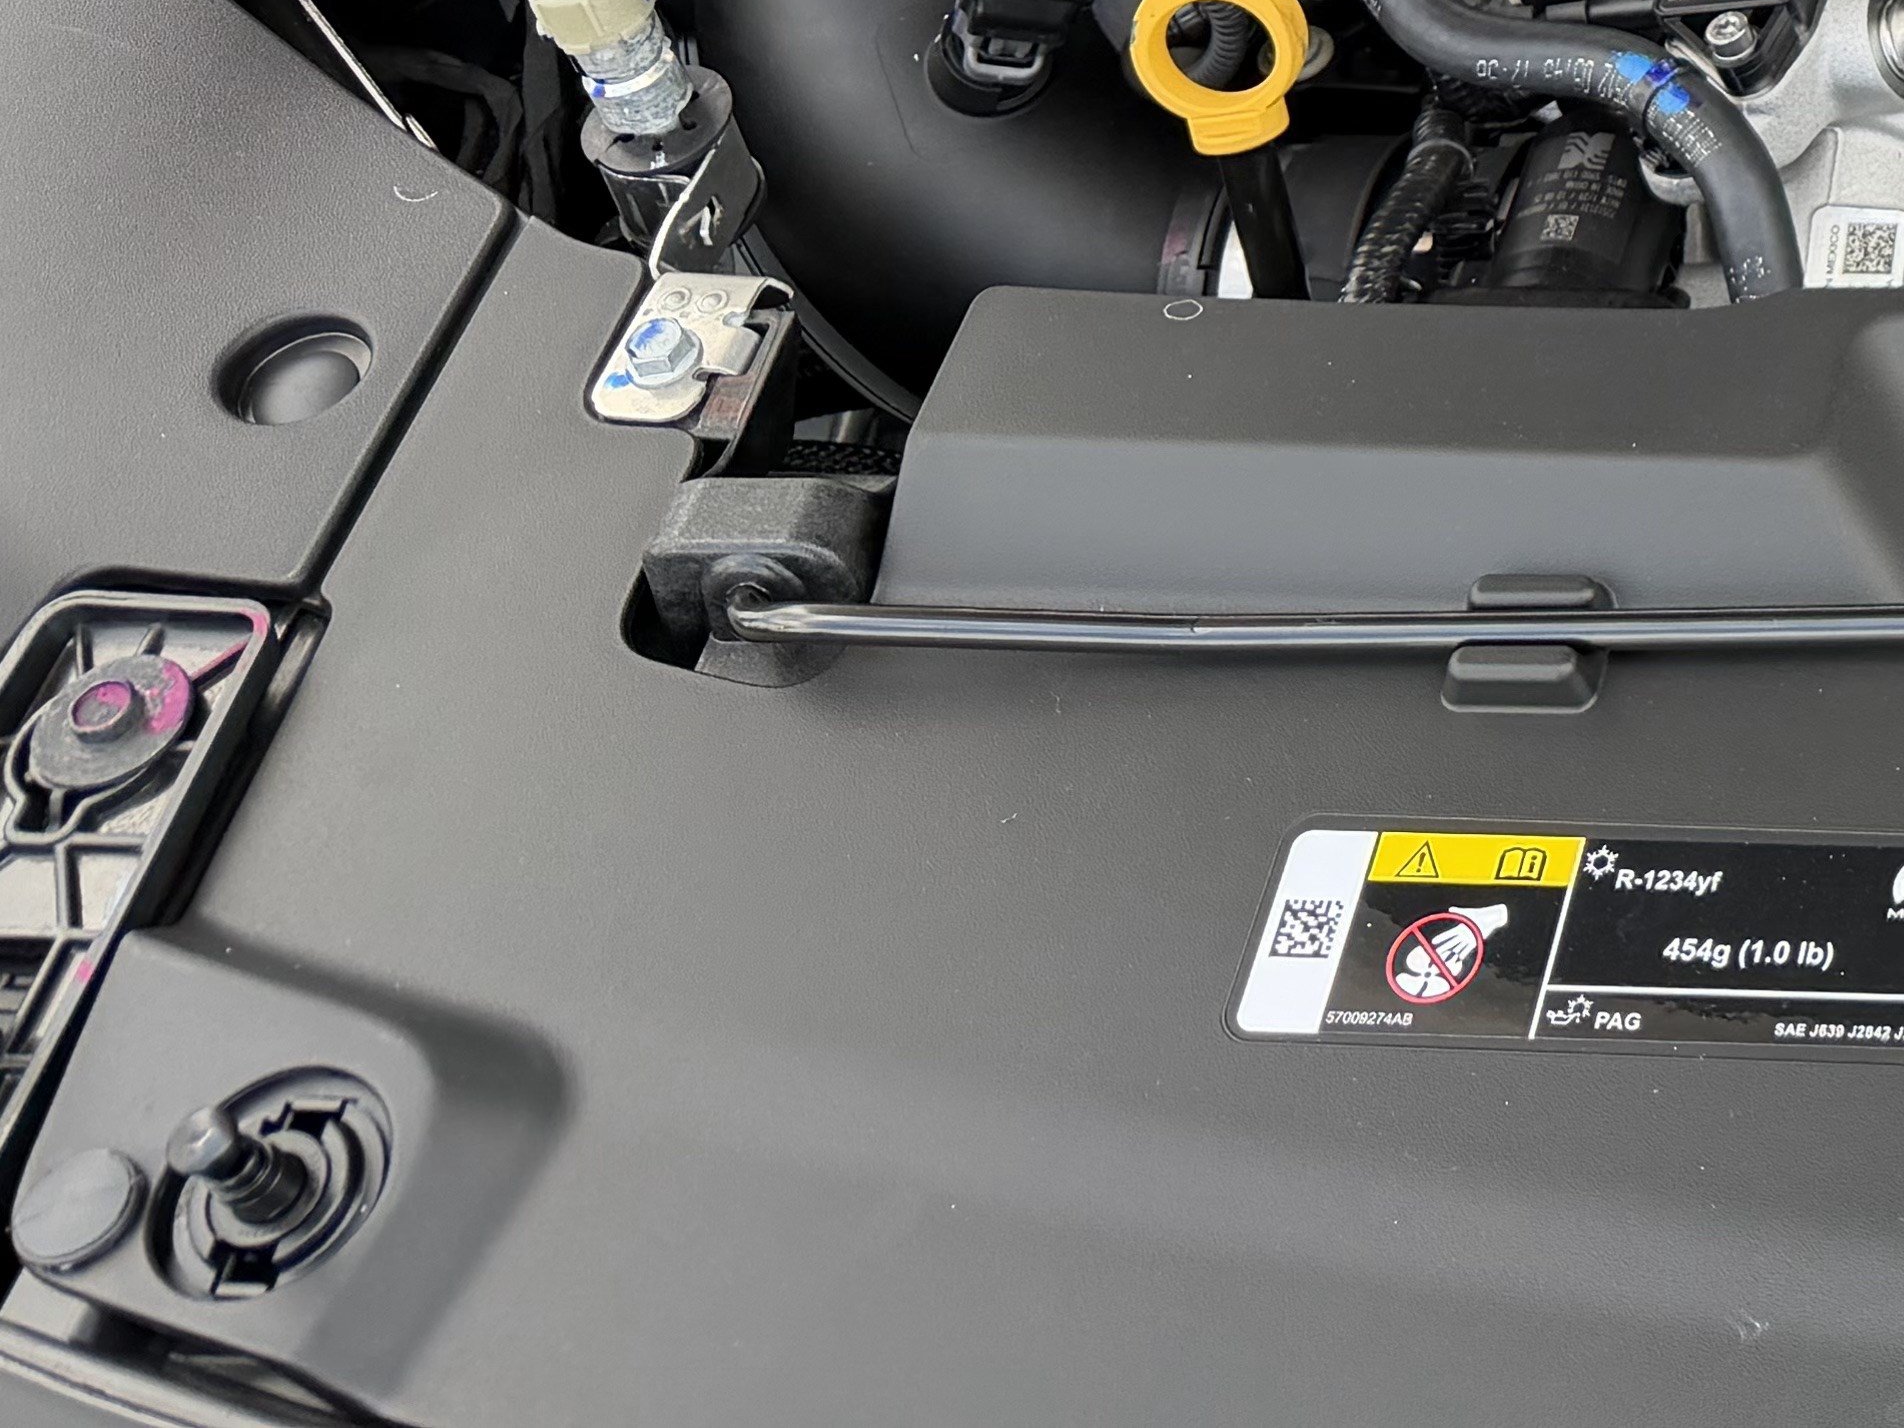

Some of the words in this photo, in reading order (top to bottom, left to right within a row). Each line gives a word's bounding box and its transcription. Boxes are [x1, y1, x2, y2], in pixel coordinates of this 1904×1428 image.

[1826, 224, 1841, 272] MEXICO
[1615, 866, 1723, 895] R-1234yf
[1662, 940, 1730, 970] 454g
[1737, 940, 1791, 969] (1.0
[1797, 941, 1836, 971] lb)
[1594, 1010, 1642, 1032] PAG
[1774, 1023, 1807, 1039] SAE
[1809, 1024, 1845, 1040] J639
